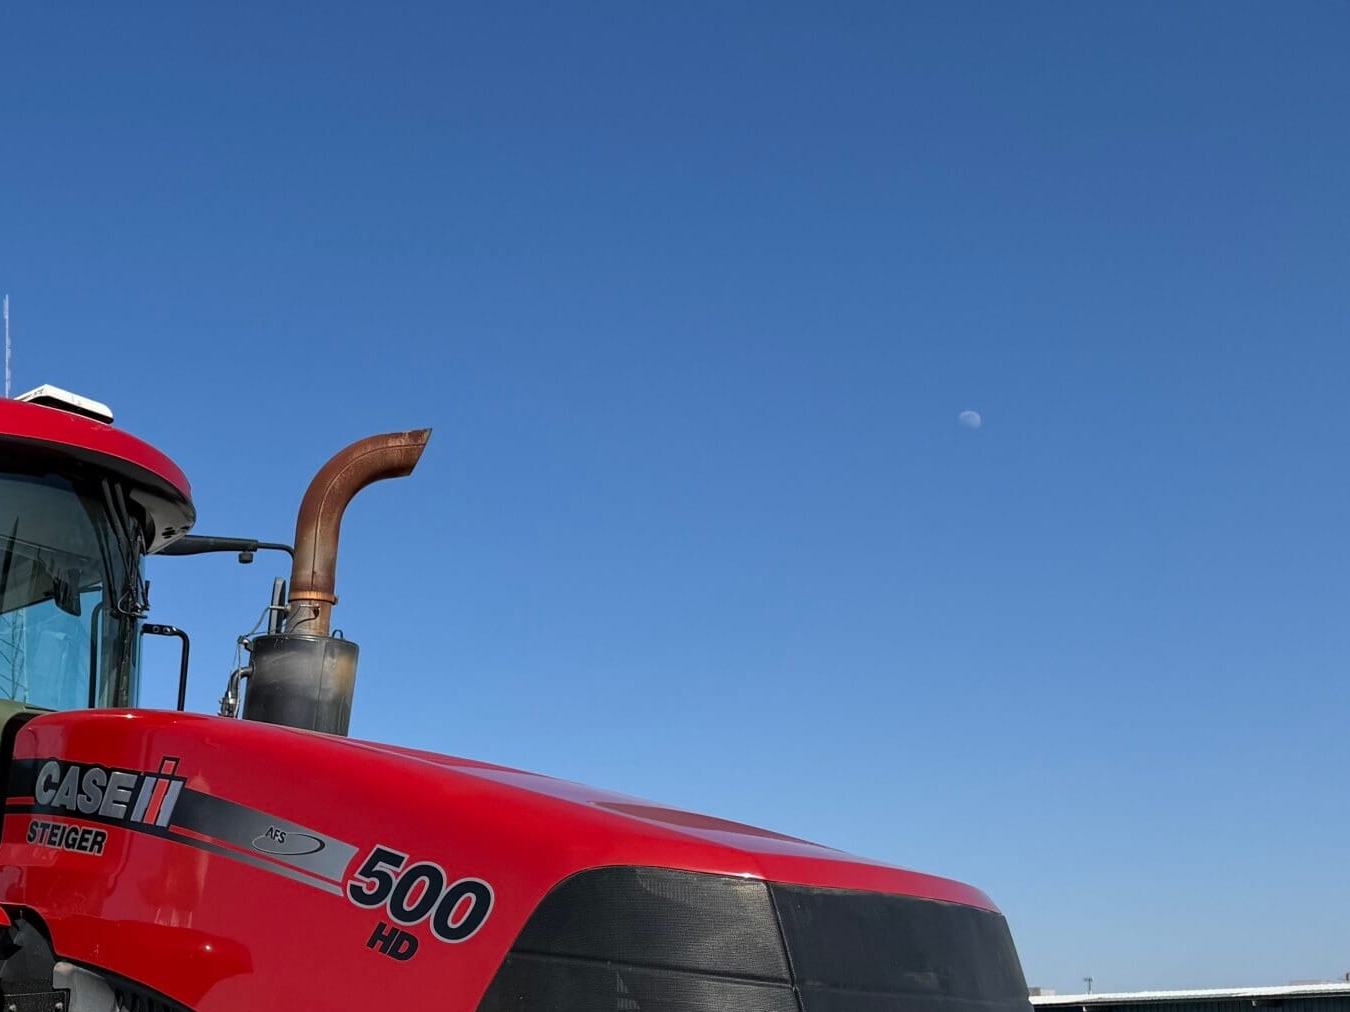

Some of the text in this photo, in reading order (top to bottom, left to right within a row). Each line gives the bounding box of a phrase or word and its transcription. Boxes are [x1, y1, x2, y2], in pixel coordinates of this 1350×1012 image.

[35, 761, 138, 819] CASE
[26, 820, 108, 856] STEIGER
[265, 826, 287, 844] AFS
[347, 844, 495, 943] 500
[366, 921, 419, 961] HD
